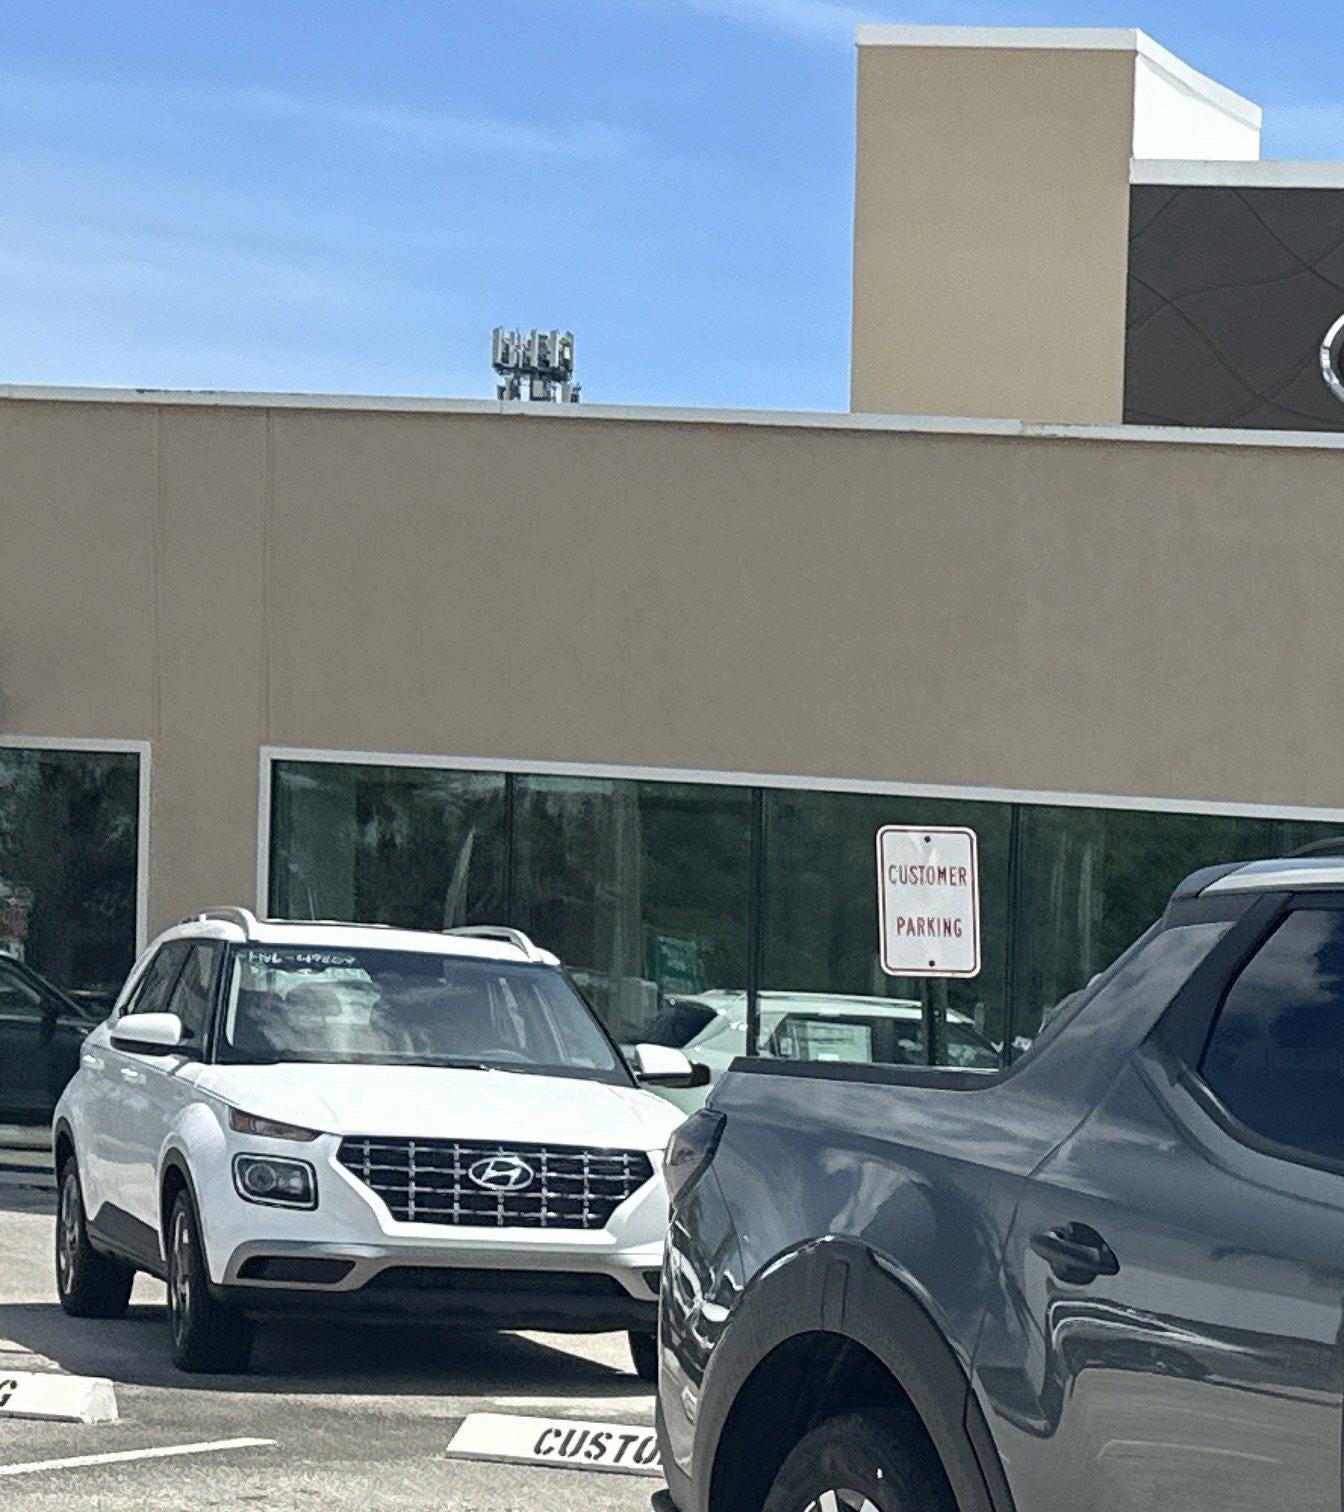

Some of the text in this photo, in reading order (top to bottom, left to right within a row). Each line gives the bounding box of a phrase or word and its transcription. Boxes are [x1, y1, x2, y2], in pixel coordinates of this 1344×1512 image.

[888, 864, 967, 887] CUSTOMER
[896, 916, 962, 938] PARKING
[533, 1427, 662, 1466] CUSTO
